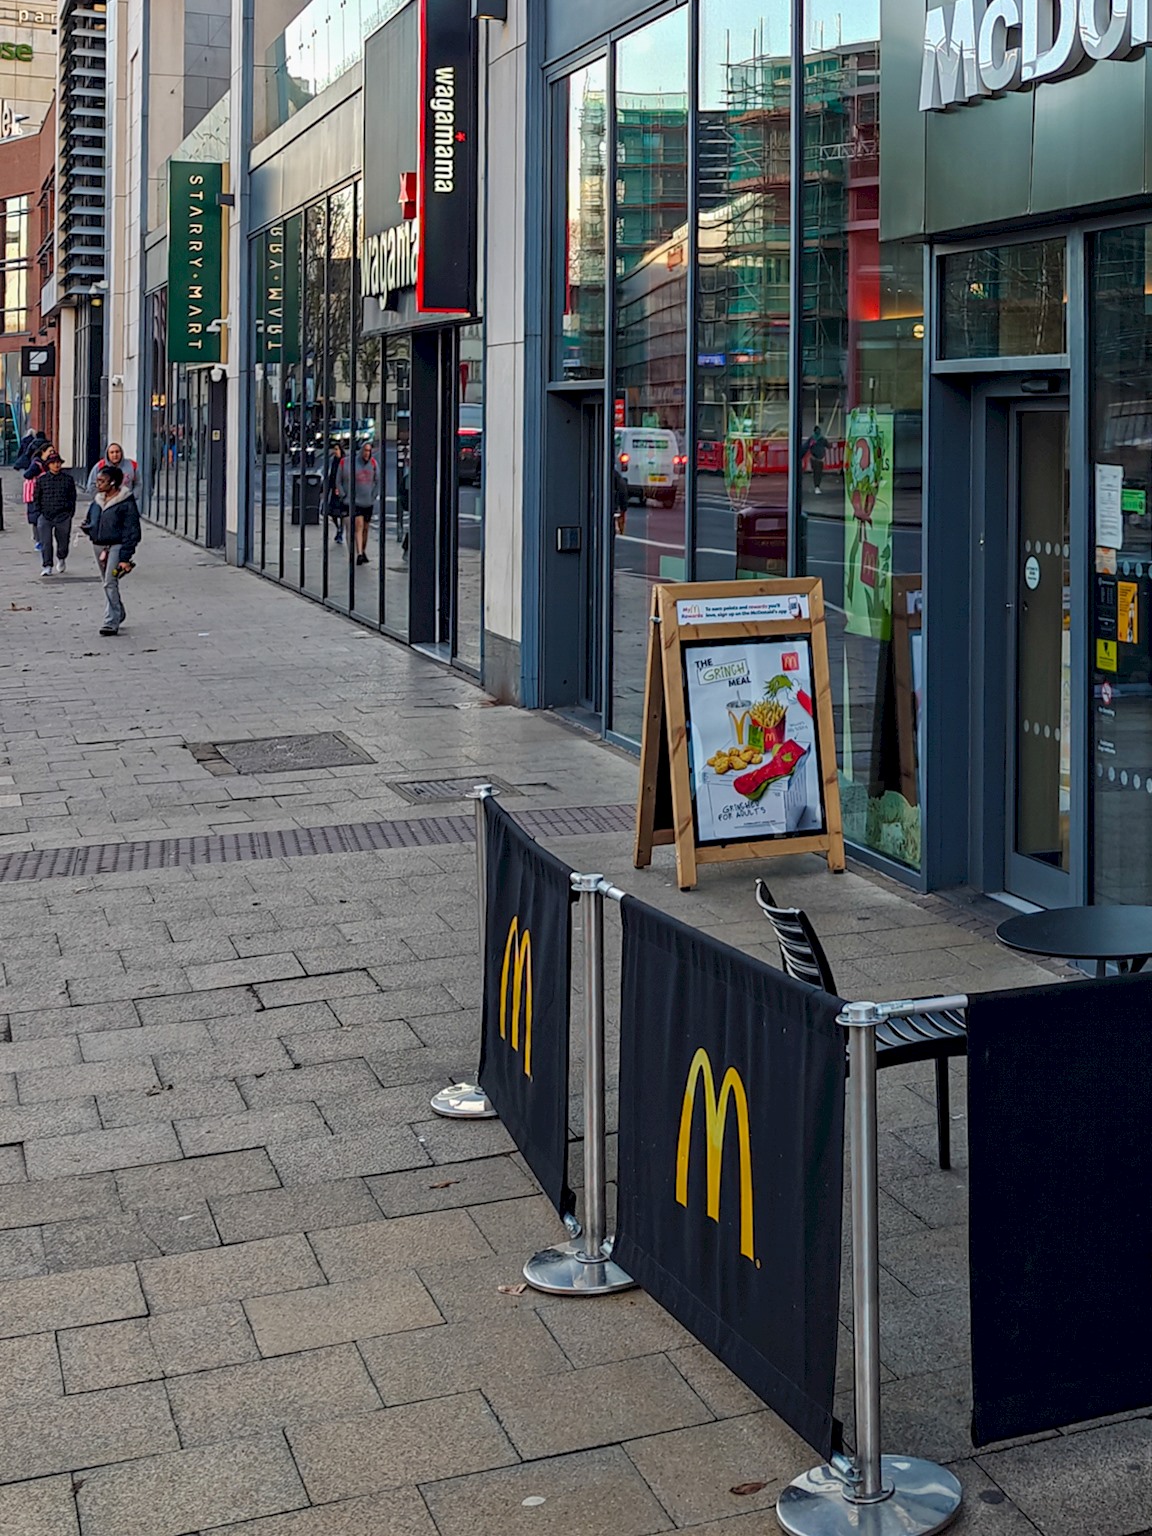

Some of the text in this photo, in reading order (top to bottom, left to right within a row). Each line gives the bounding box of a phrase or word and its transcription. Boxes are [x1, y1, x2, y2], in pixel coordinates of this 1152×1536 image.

[430, 66, 454, 193] wagamama
[187, 285, 203, 350] MART
[695, 658, 713, 669] THE
[728, 676, 751, 687] MEAL
[718, 806, 766, 822] FOR ADULTS
